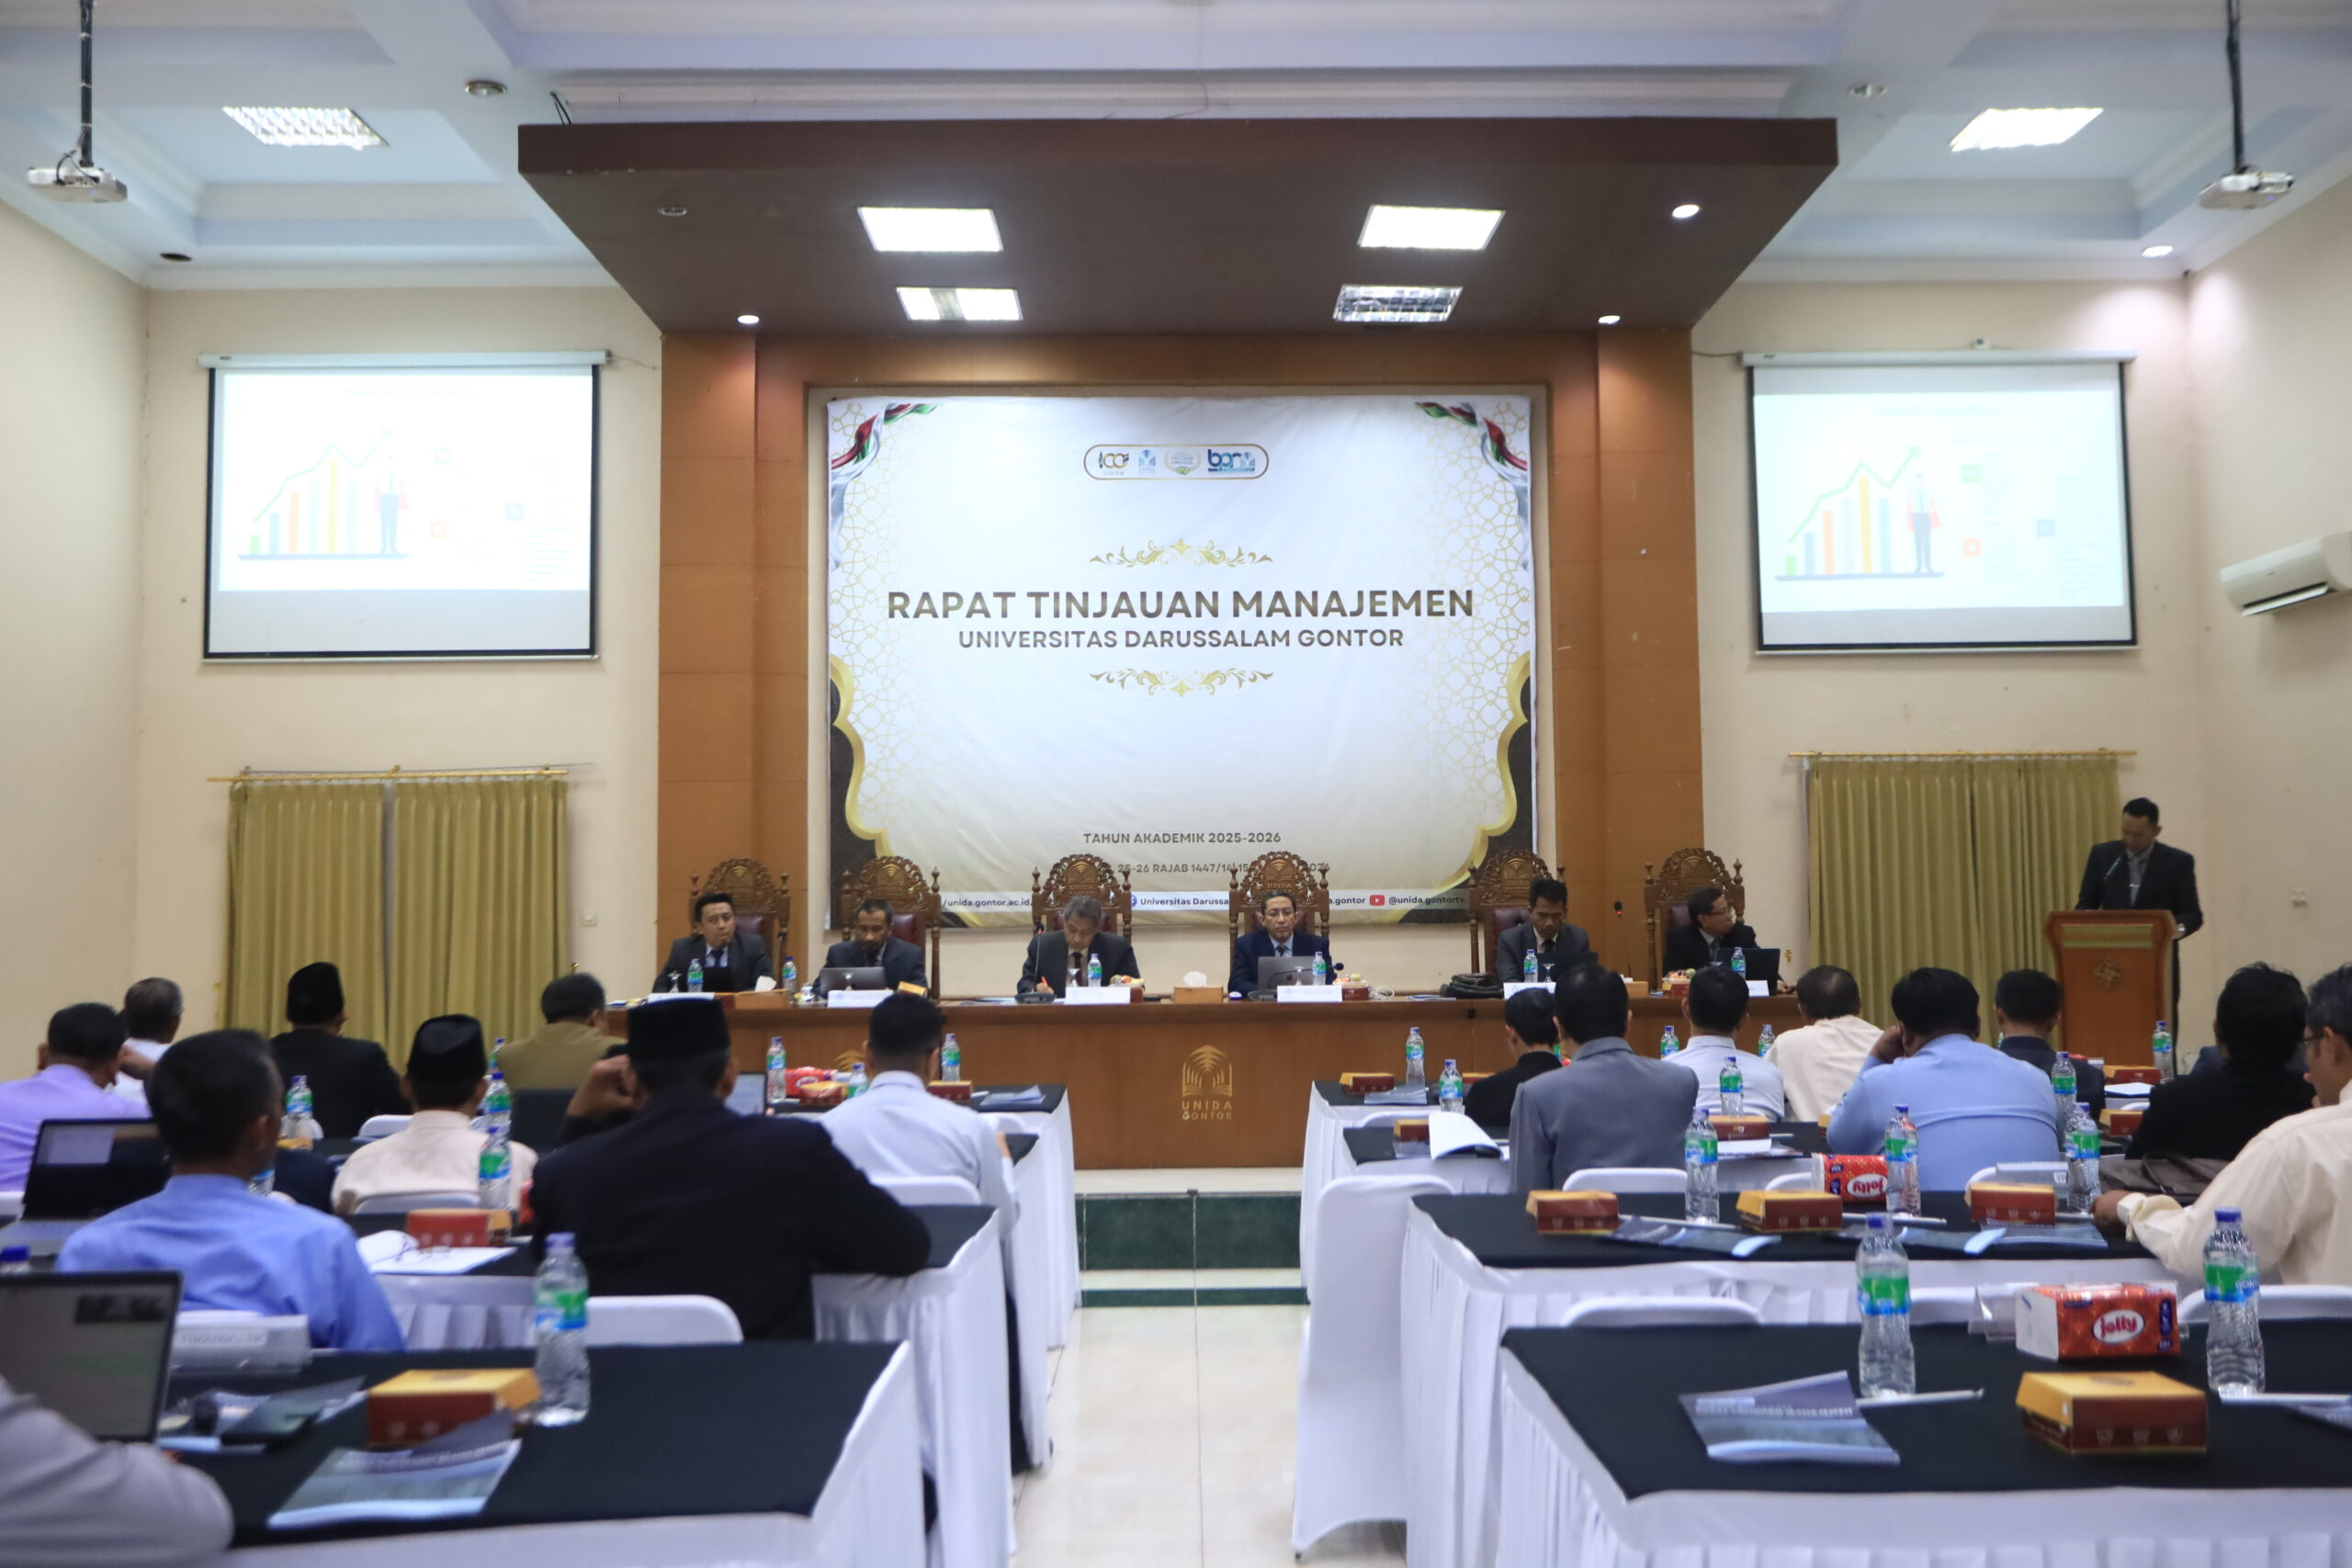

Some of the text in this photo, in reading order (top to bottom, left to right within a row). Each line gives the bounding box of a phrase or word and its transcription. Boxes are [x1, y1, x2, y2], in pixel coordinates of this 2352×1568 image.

[888, 590, 1473, 619] RAPAT TINJAUAN MANAJEMEN
[958, 628, 1404, 649] UNIVERSITAS DARUSSALAM GONTOR
[1082, 831, 1282, 844] TAHUN AKADEMIK 2025-2026
[1152, 863, 1189, 874] RAJAB
[1192, 863, 1250, 874] 1447/1415
[1140, 897, 1229, 906] Universitas Darussa
[1388, 897, 1465, 906] @unida.gontortv
[1182, 1100, 1232, 1111] UNIDA
